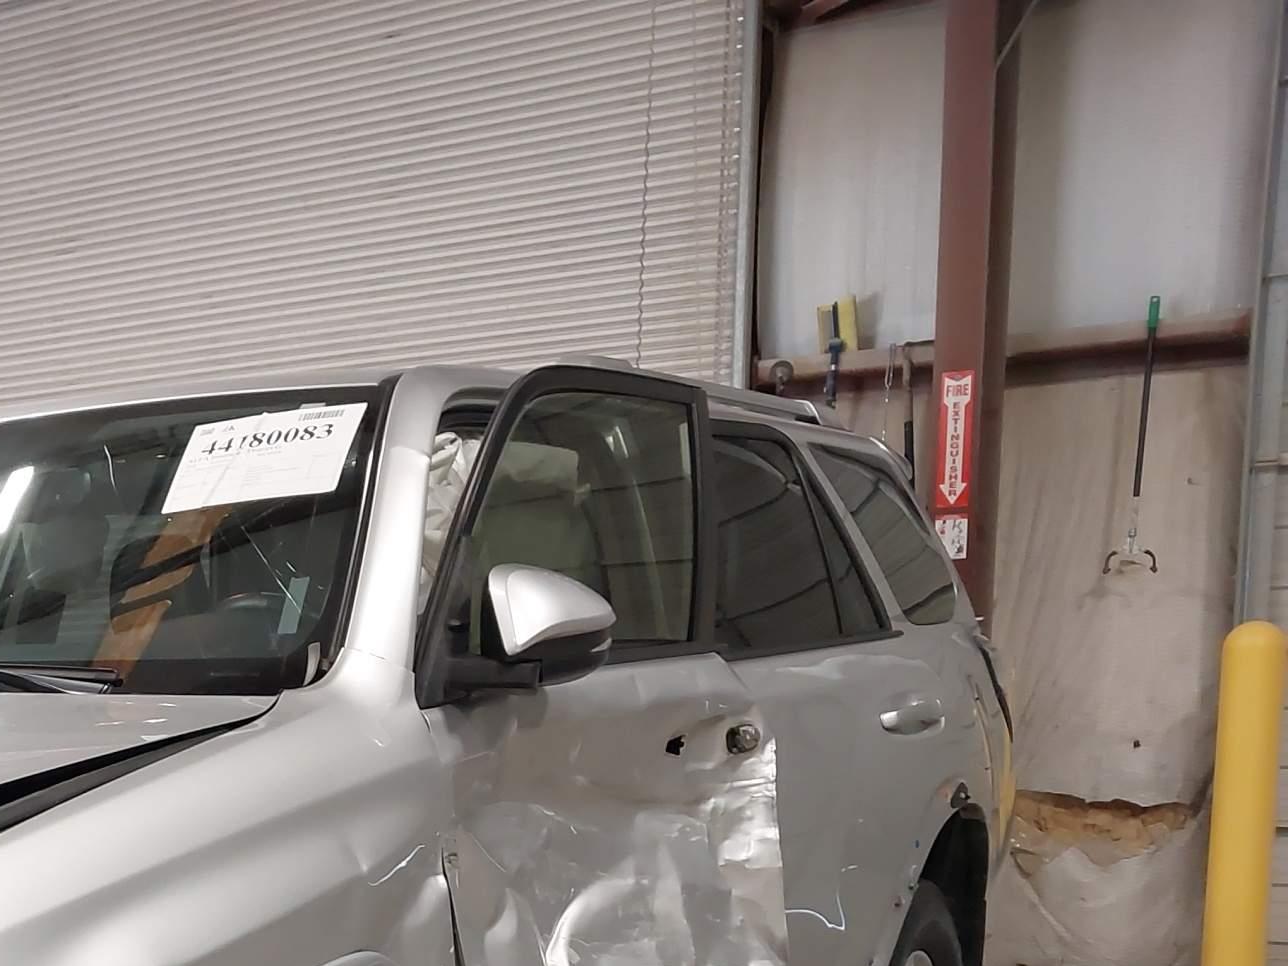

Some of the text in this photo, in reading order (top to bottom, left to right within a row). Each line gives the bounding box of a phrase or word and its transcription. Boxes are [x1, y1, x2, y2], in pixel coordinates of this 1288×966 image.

[946, 384, 970, 398] FIRE
[201, 424, 334, 455] 44180083
[948, 401, 961, 497] EXTINGUISHER
